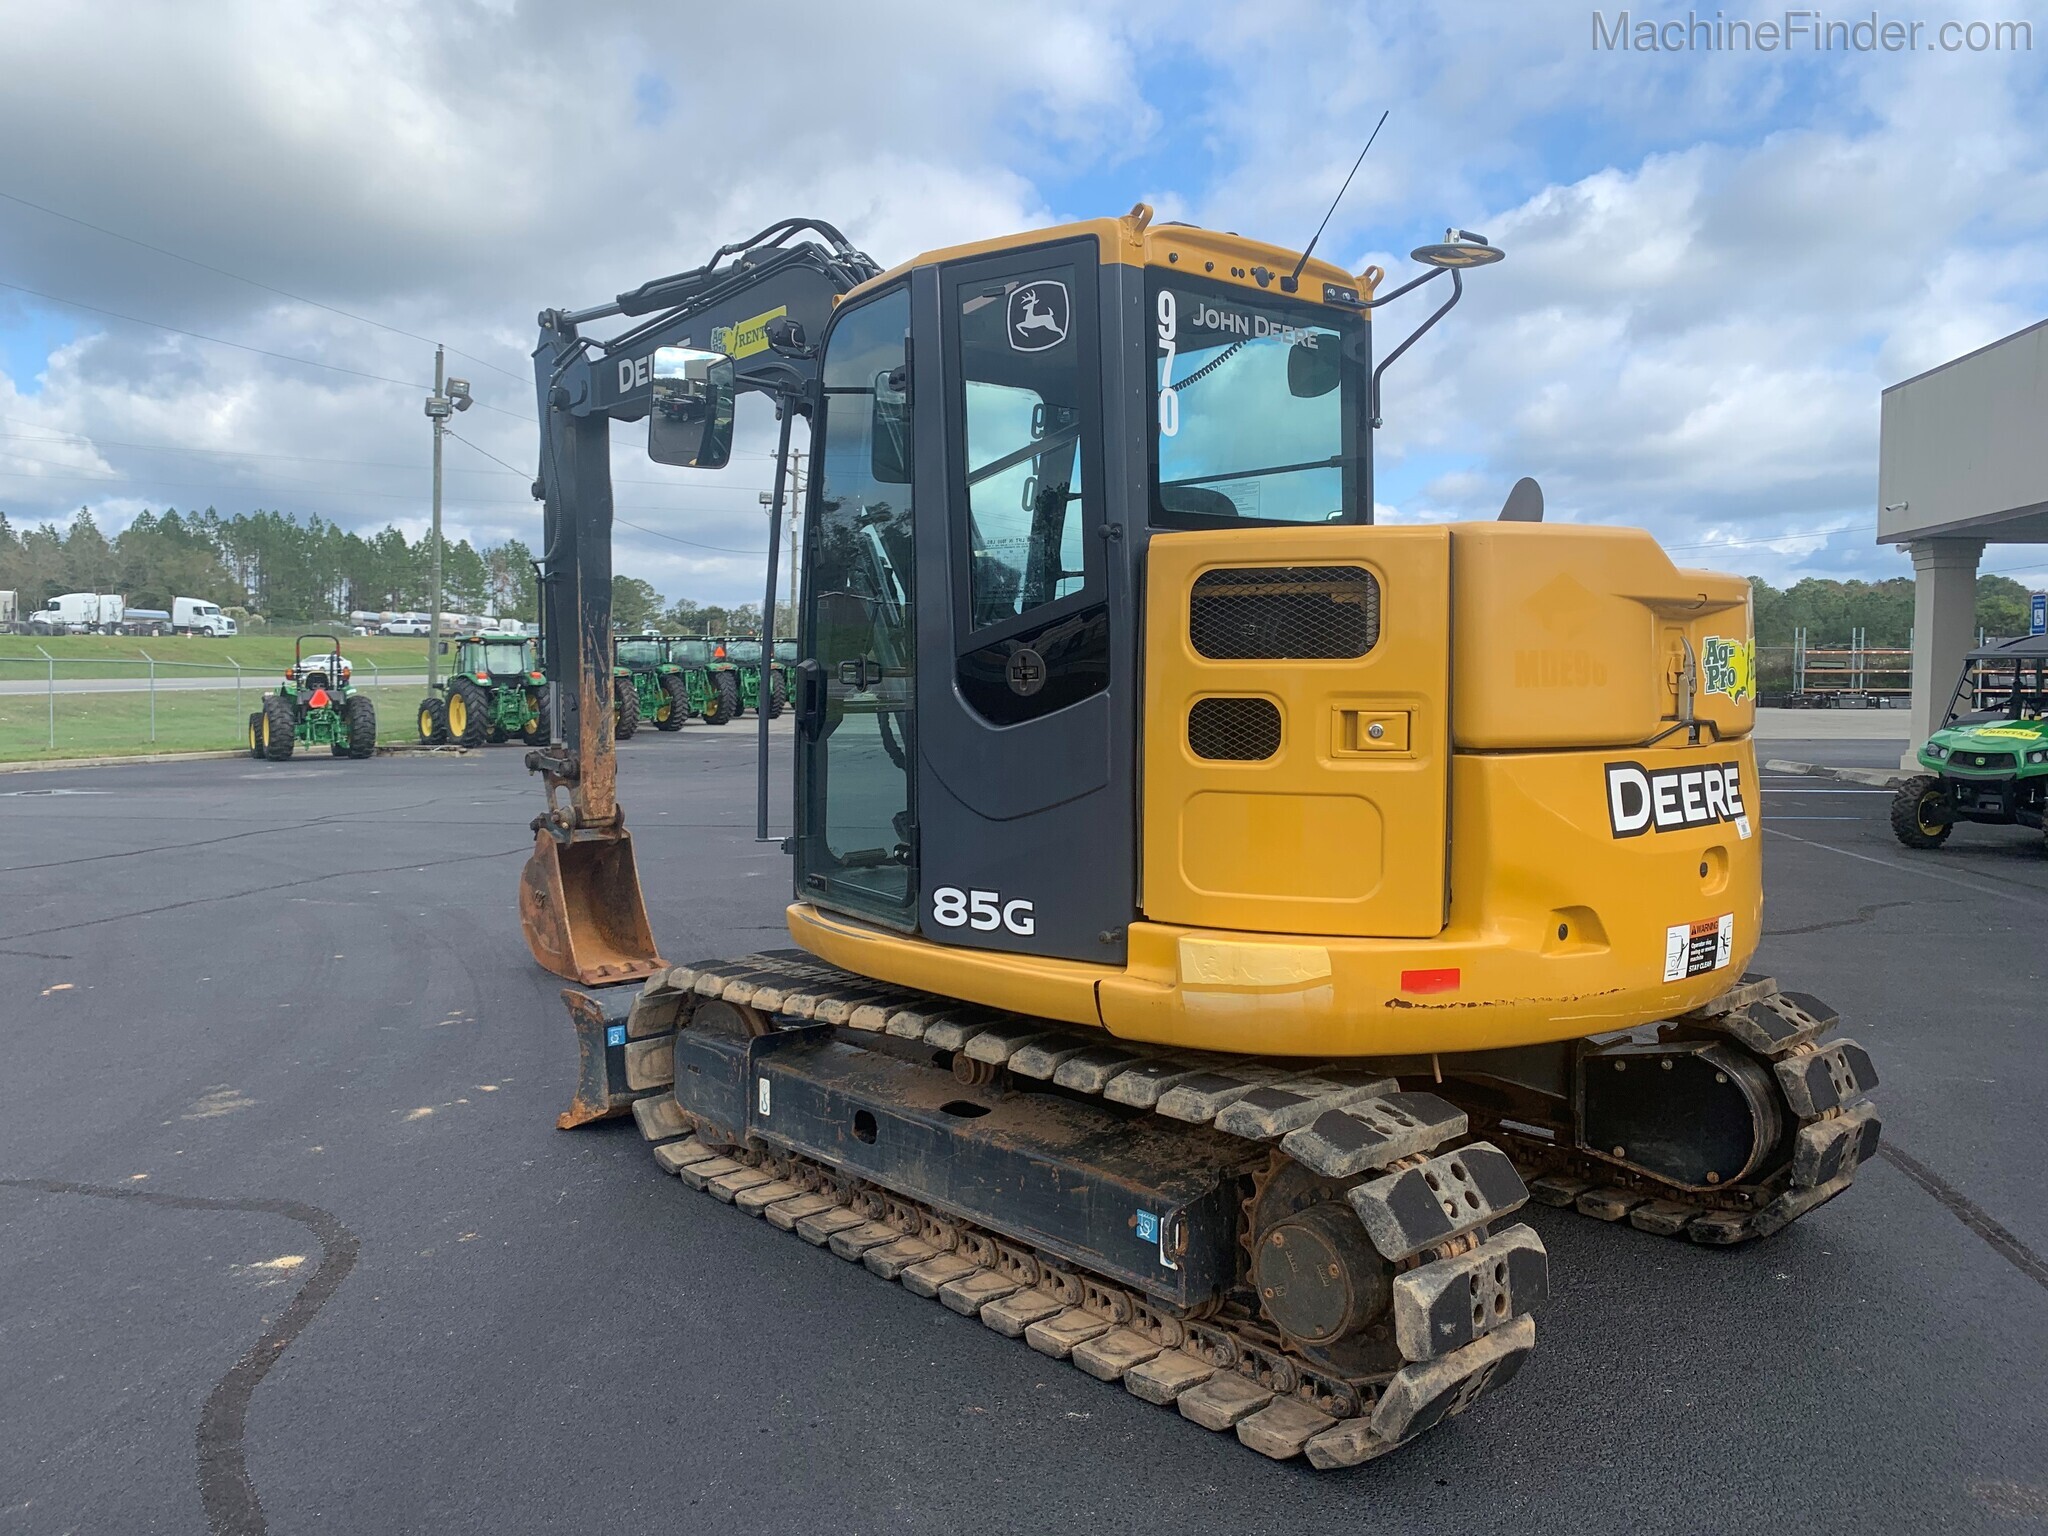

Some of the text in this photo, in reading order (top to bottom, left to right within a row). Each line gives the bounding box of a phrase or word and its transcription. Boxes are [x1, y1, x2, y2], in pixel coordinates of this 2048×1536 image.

[739, 326, 768, 348] RENT
[1706, 665, 1736, 691] Pro
[1608, 766, 1744, 832] DEERE
[933, 887, 1035, 936] 85G
[1697, 921, 1718, 933] WARNING
